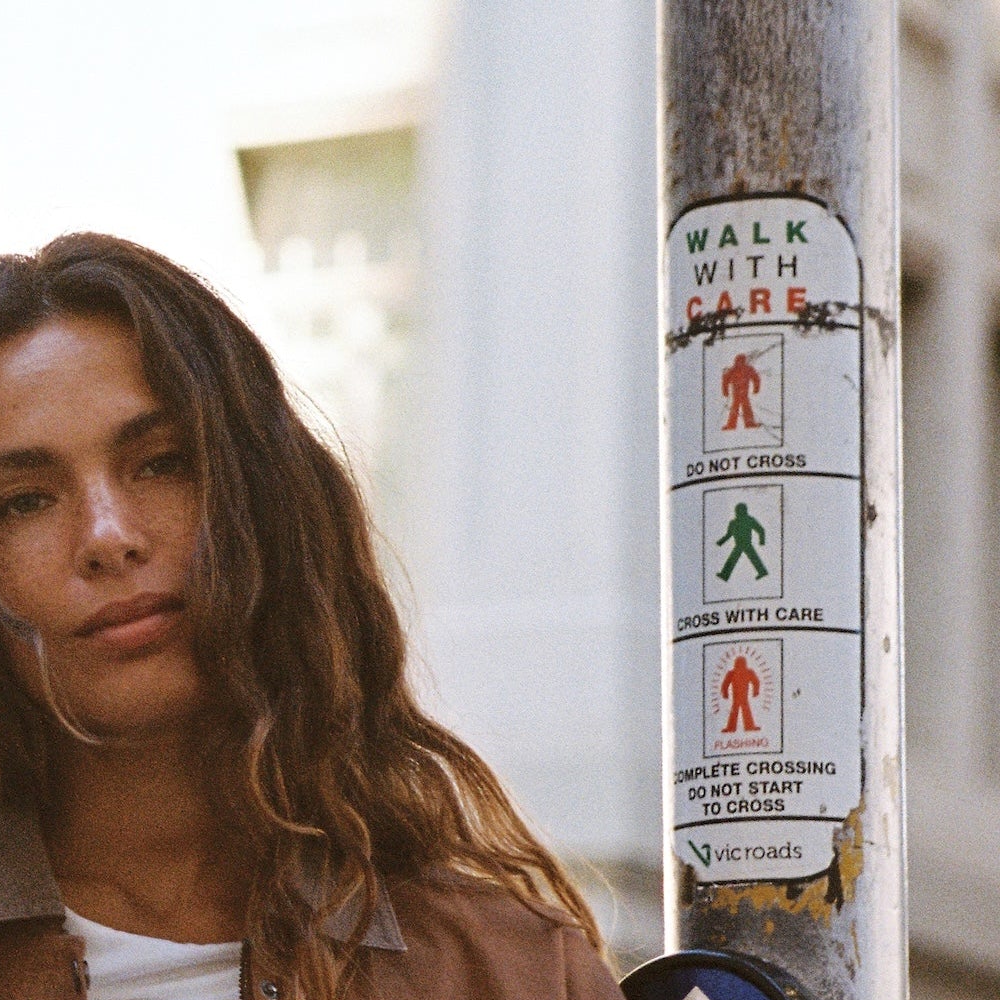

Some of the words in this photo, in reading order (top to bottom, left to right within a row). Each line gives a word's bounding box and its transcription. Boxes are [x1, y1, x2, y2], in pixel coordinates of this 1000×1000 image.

[686, 220, 808, 254] WALK
[694, 255, 797, 286] WITH
[686, 287, 807, 321] CARE
[686, 461, 704, 477] DO
[709, 457, 740, 473] NOT
[747, 454, 807, 469] CROSS
[677, 612, 720, 631] CROSS
[725, 608, 769, 623] WITH
[775, 607, 824, 621] CARE
[713, 737, 769, 750] FLASHING
[746, 761, 836, 775] CROSSING
[688, 786, 706, 800] DO
[711, 783, 743, 797] NOT
[748, 781, 803, 794] START
[703, 802, 721, 816] TO
[726, 799, 785, 814] CROSS
[714, 841, 802, 862] vicroads
